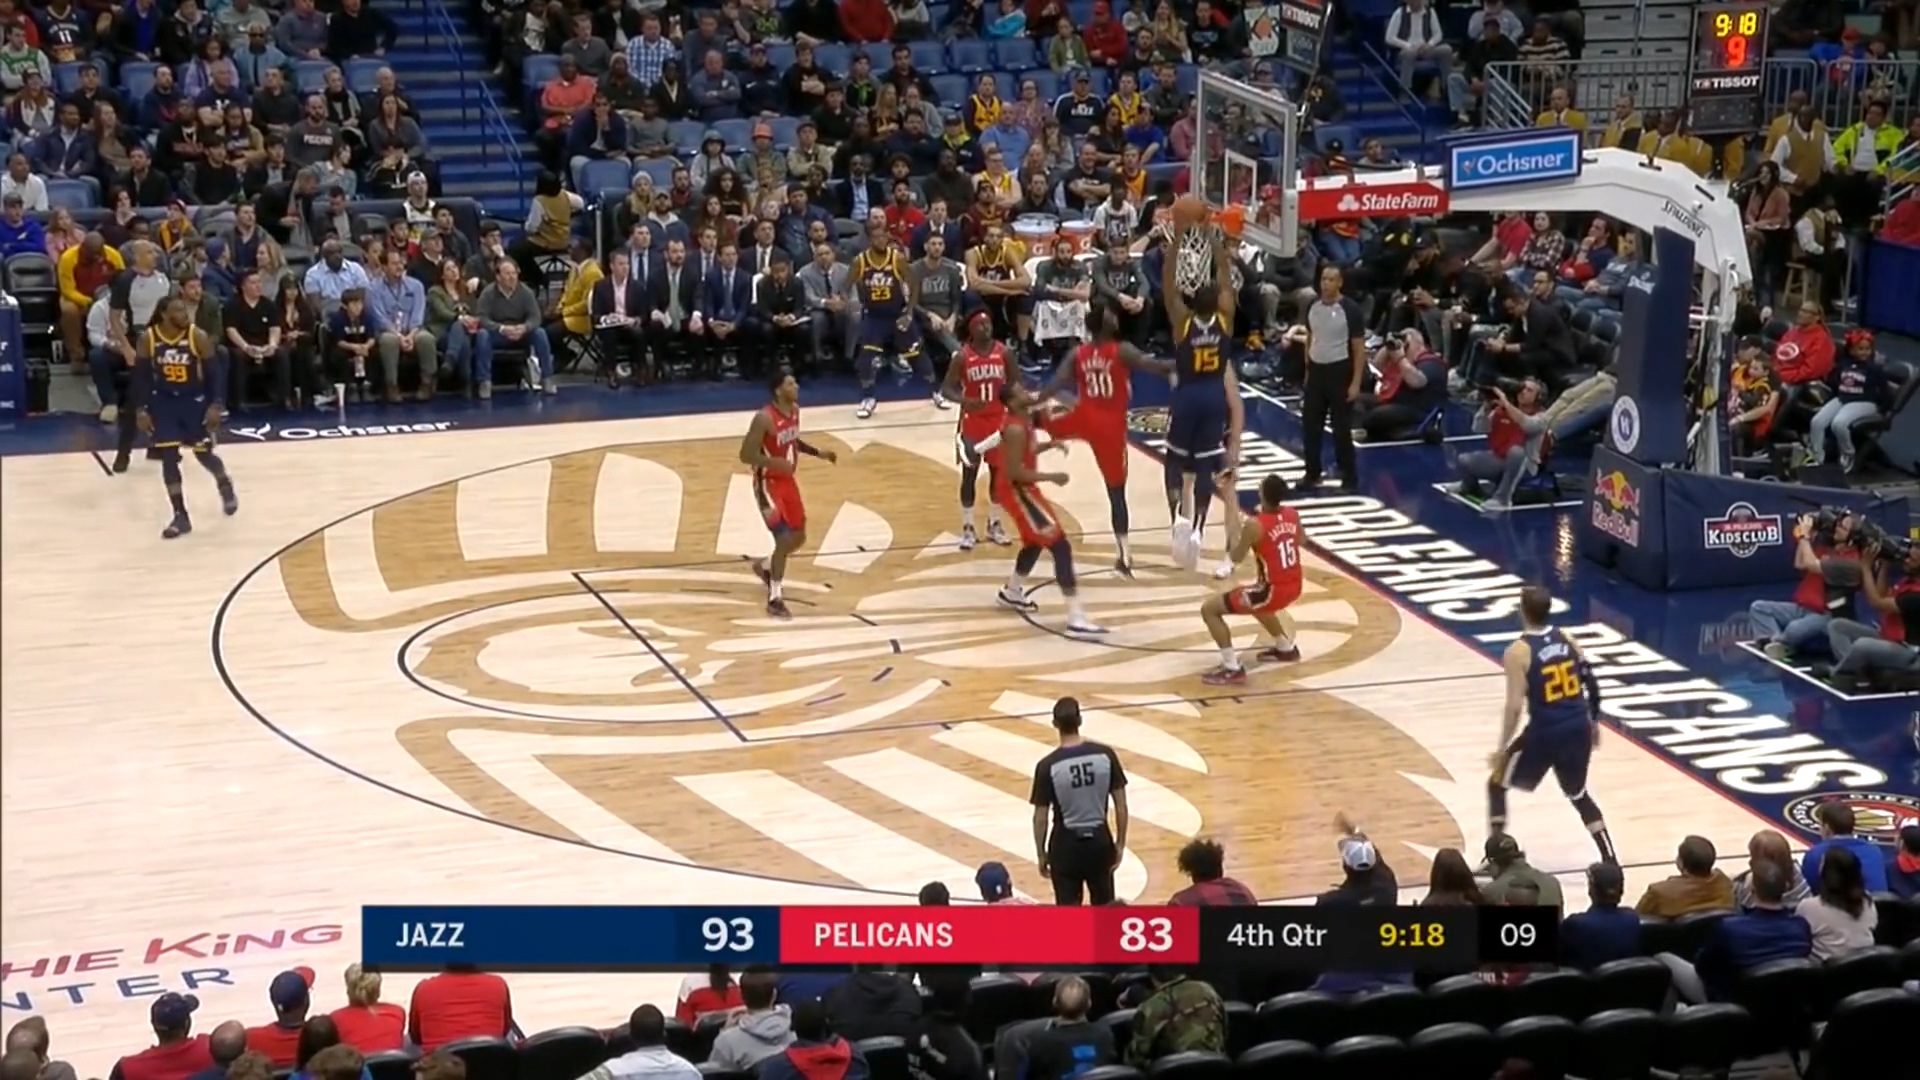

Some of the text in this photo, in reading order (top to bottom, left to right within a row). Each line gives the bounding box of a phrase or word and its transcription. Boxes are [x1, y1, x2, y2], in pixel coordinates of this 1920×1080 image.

[58, 30, 72, 43] 11
[1716, 12, 1757, 37] 9:18
[1727, 36, 1746, 66] 9
[1712, 75, 1759, 88] TISSOT
[1477, 151, 1565, 175] Ochsner
[871, 286, 891, 300] 23
[1193, 347, 1219, 372] 15
[162, 365, 188, 383] 99
[1085, 371, 1114, 399] 30
[980, 382, 994, 401] 11
[278, 420, 452, 439] Ochsner
[1278, 538, 1298, 569] 15
[1278, 496, 1571, 621] ORLEANS
[1473, 622, 1887, 794] PELICANS
[1541, 660, 1580, 703] 26
[1069, 762, 1096, 788] 35
